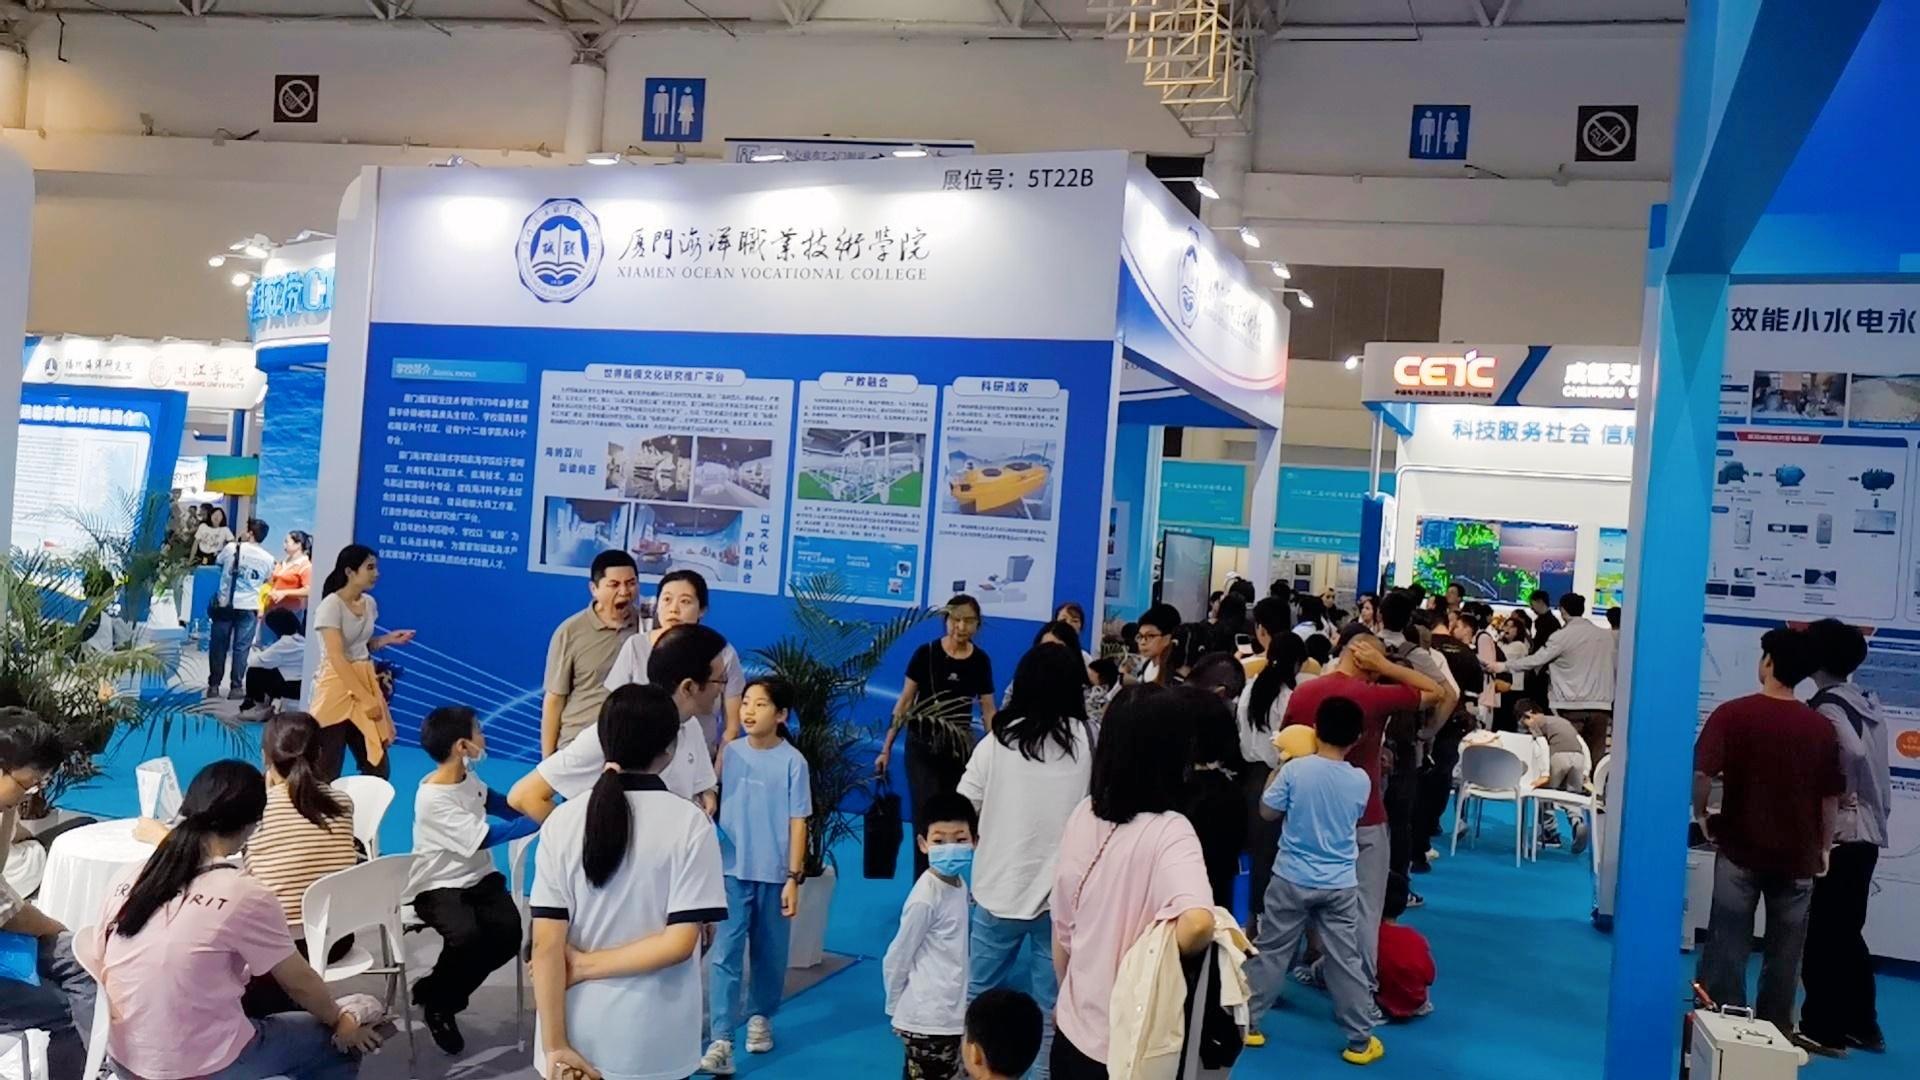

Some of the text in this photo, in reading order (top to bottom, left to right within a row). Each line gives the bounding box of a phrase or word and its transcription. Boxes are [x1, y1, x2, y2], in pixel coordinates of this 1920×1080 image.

[1028, 168, 1093, 188] 5T22B
[616, 266, 928, 281] XIAMEN OCEAN VOCATIONAL COLLEGE
[1730, 306, 1917, 334] 效能小水电永
[1393, 350, 1496, 388] CETC
[844, 375, 889, 389] 产教融合
[981, 380, 1029, 393] 科研成效
[1452, 419, 1591, 444] 科技服务社会
[757, 513, 770, 567] 以文化人
[743, 530, 754, 584] 产教融合
